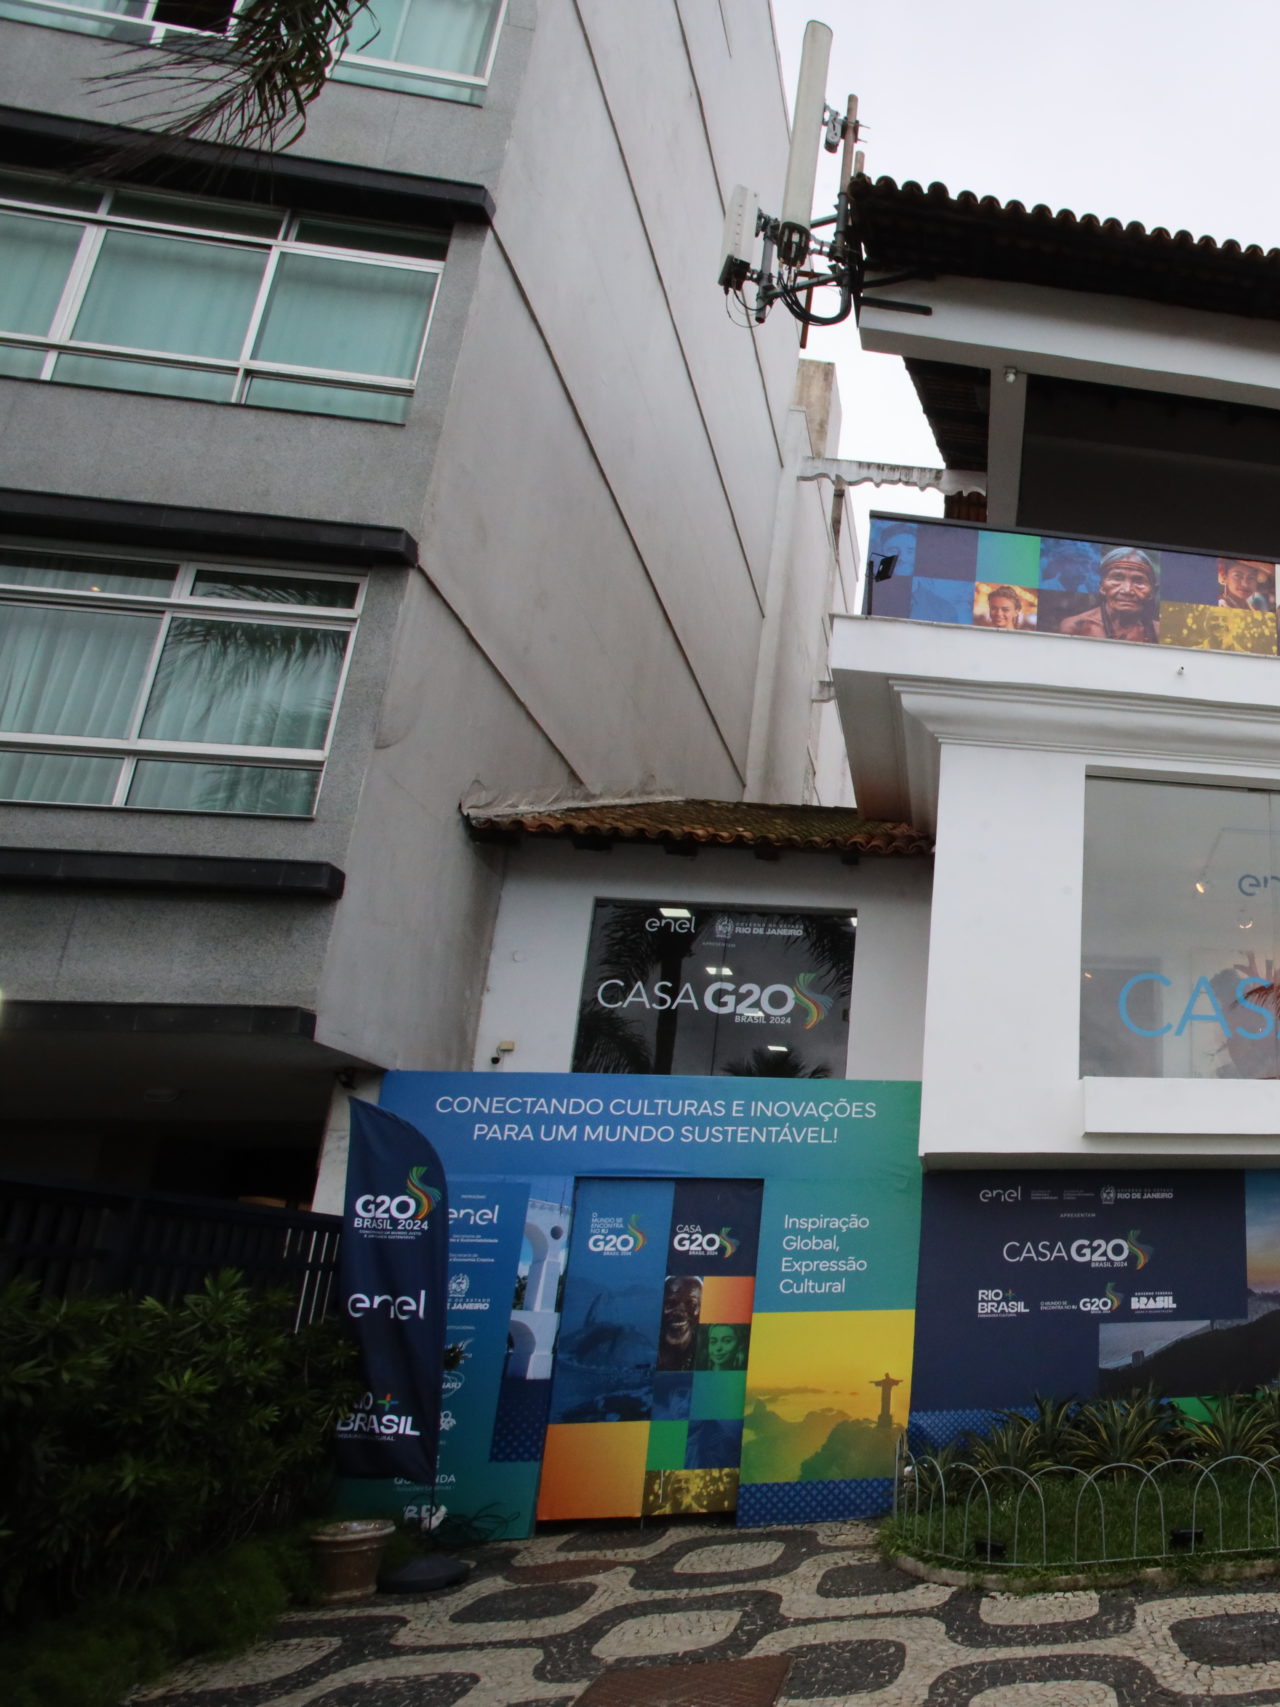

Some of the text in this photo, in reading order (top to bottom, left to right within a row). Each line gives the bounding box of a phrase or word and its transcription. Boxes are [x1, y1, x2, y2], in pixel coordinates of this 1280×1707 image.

[645, 916, 695, 933] enel
[735, 926, 803, 937] RIO DE JANEIRO
[734, 1015, 791, 1025] BRASIL 2024
[436, 1096, 877, 1122] CONECTANDO CULTURAS E INOVAÇÕES
[473, 1122, 839, 1144] PARA UM MUNDO SUSTENTÁVEL!
[979, 1186, 1022, 1202] enel
[1143, 1192, 1174, 1200] JANEIRO
[355, 1194, 417, 1220] G20
[448, 1205, 500, 1225] enel
[353, 1218, 429, 1231] BRASIL 2024
[676, 1224, 703, 1233] CASA
[784, 1214, 870, 1233] Inspiração
[588, 1234, 635, 1251] G20
[673, 1233, 720, 1251] G20
[782, 1235, 840, 1252] Global,
[781, 1257, 867, 1275] Expressão
[780, 1278, 845, 1294] Cultural
[978, 1289, 1003, 1301] RIO
[1130, 1296, 1177, 1309] BRASIL
[348, 1290, 426, 1320] enel
[452, 1302, 490, 1310] JANEIRO
[977, 1302, 1030, 1314] BRASIL
[1079, 1298, 1112, 1311] G20
[336, 1413, 421, 1437] BRASIL
